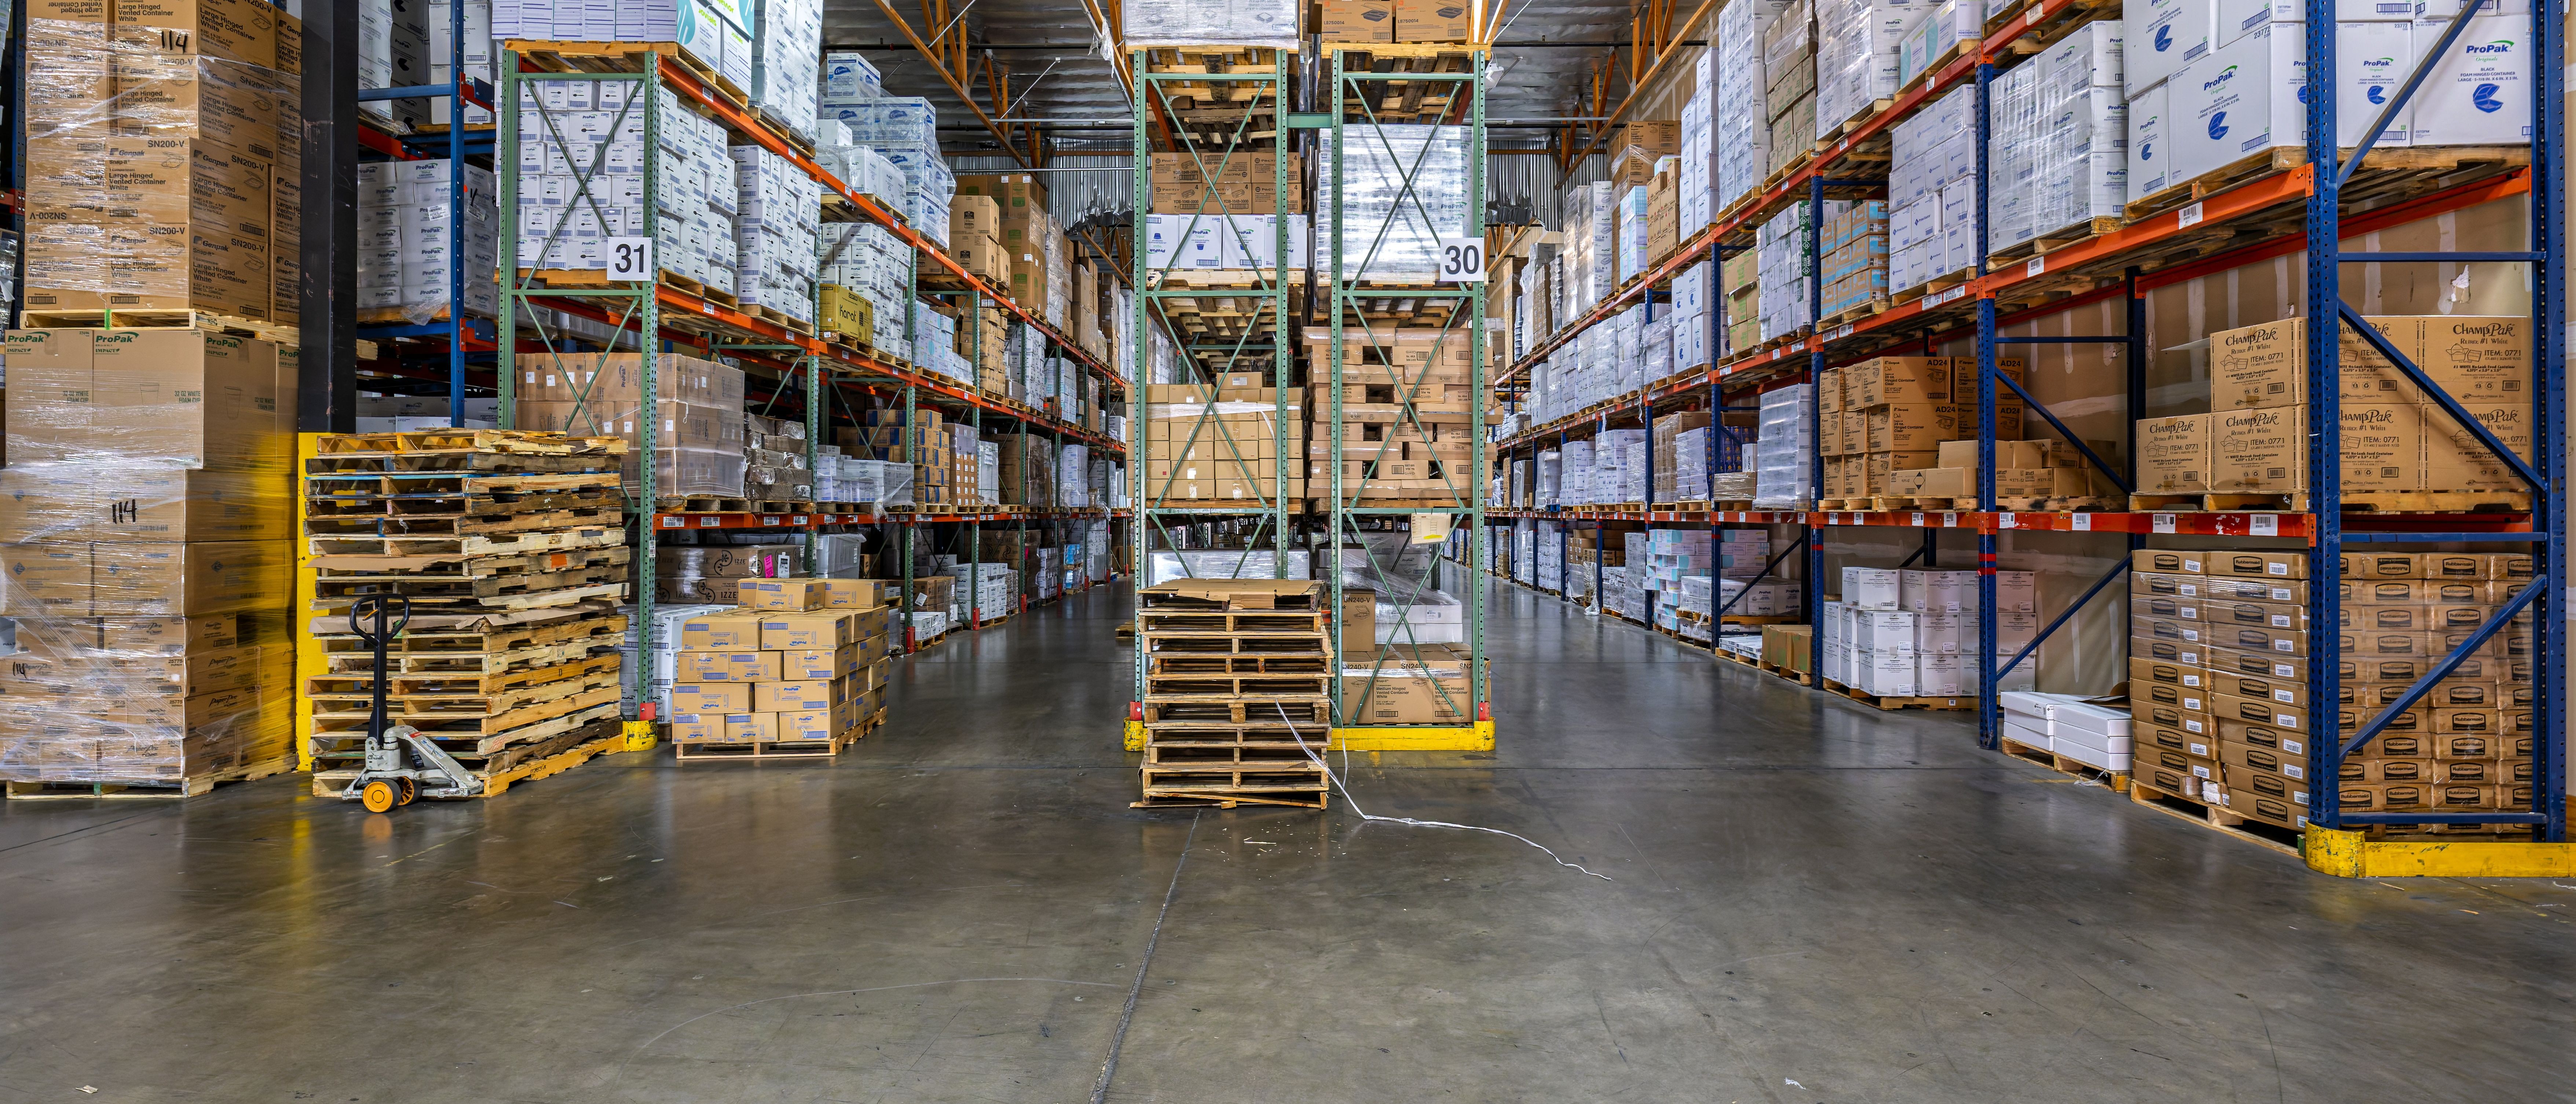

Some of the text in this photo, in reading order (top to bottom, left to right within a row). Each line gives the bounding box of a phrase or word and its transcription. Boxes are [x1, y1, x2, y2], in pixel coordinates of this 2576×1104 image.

[200, 7, 243, 30] Large Hinged
[200, 19, 219, 32] White
[2254, 26, 2270, 39] 23772
[161, 29, 189, 54] 114
[2056, 50, 2072, 63] ProPak
[2204, 71, 2233, 91] ProPak
[2054, 114, 2071, 127] ProPak
[231, 155, 264, 171] SN200-V
[202, 240, 229, 252] Genpak
[231, 238, 264, 252] SN200-V
[615, 244, 644, 273] 31
[1445, 245, 1479, 274] 30
[839, 304, 856, 322] Karat
[206, 337, 238, 348] ProPak
[113, 500, 136, 524] 114
[2159, 732, 2181, 741] Rubbermaid
[2249, 753, 2275, 763] Rubbermaid
[2259, 802, 2285, 813] Rubbermaid
